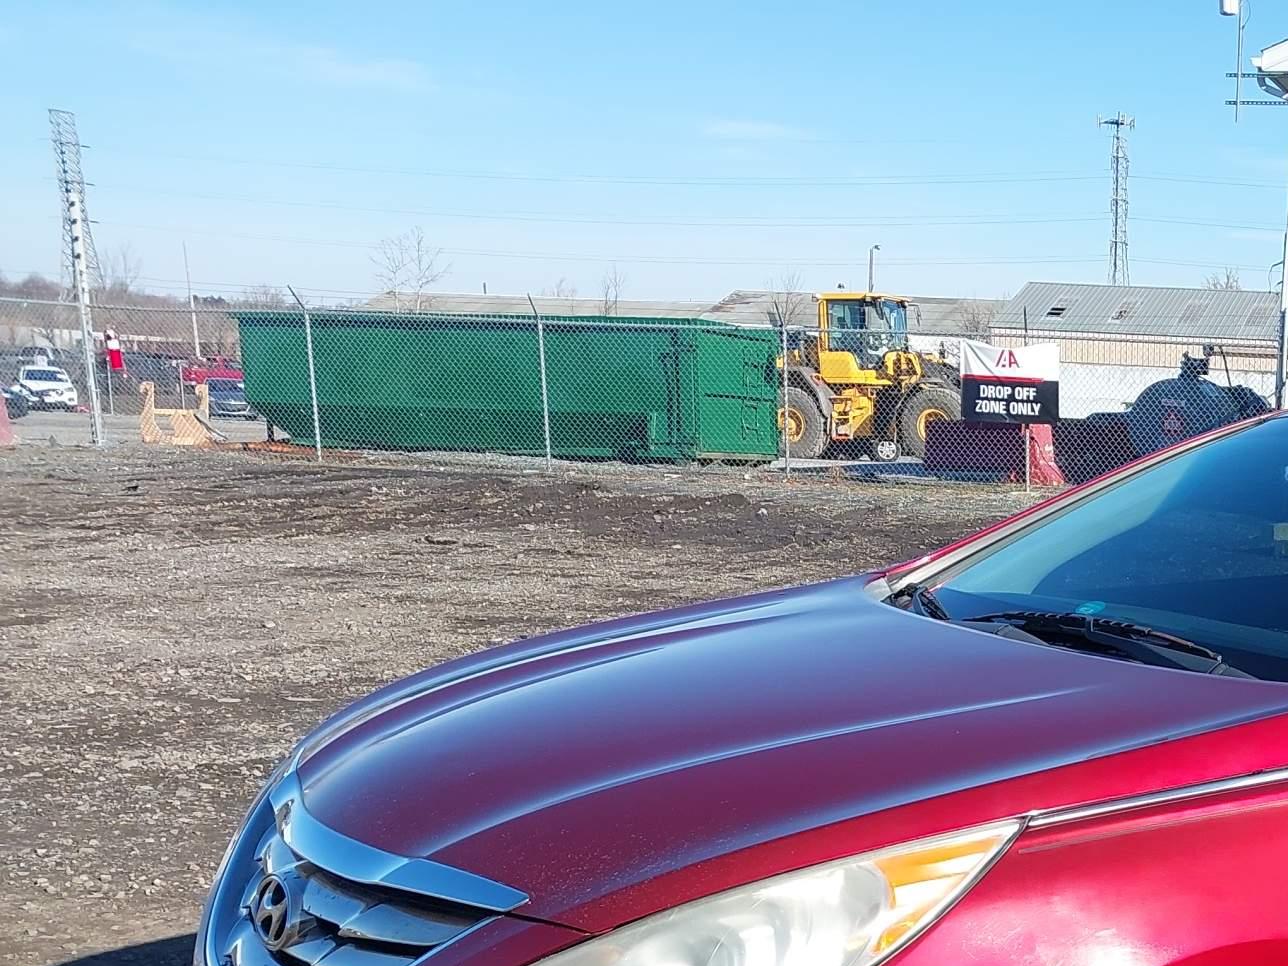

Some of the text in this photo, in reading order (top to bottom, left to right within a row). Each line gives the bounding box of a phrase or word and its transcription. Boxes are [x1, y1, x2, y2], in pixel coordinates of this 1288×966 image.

[980, 385, 1037, 400] DROP OFF
[975, 400, 1041, 415] ZONE ONLY
